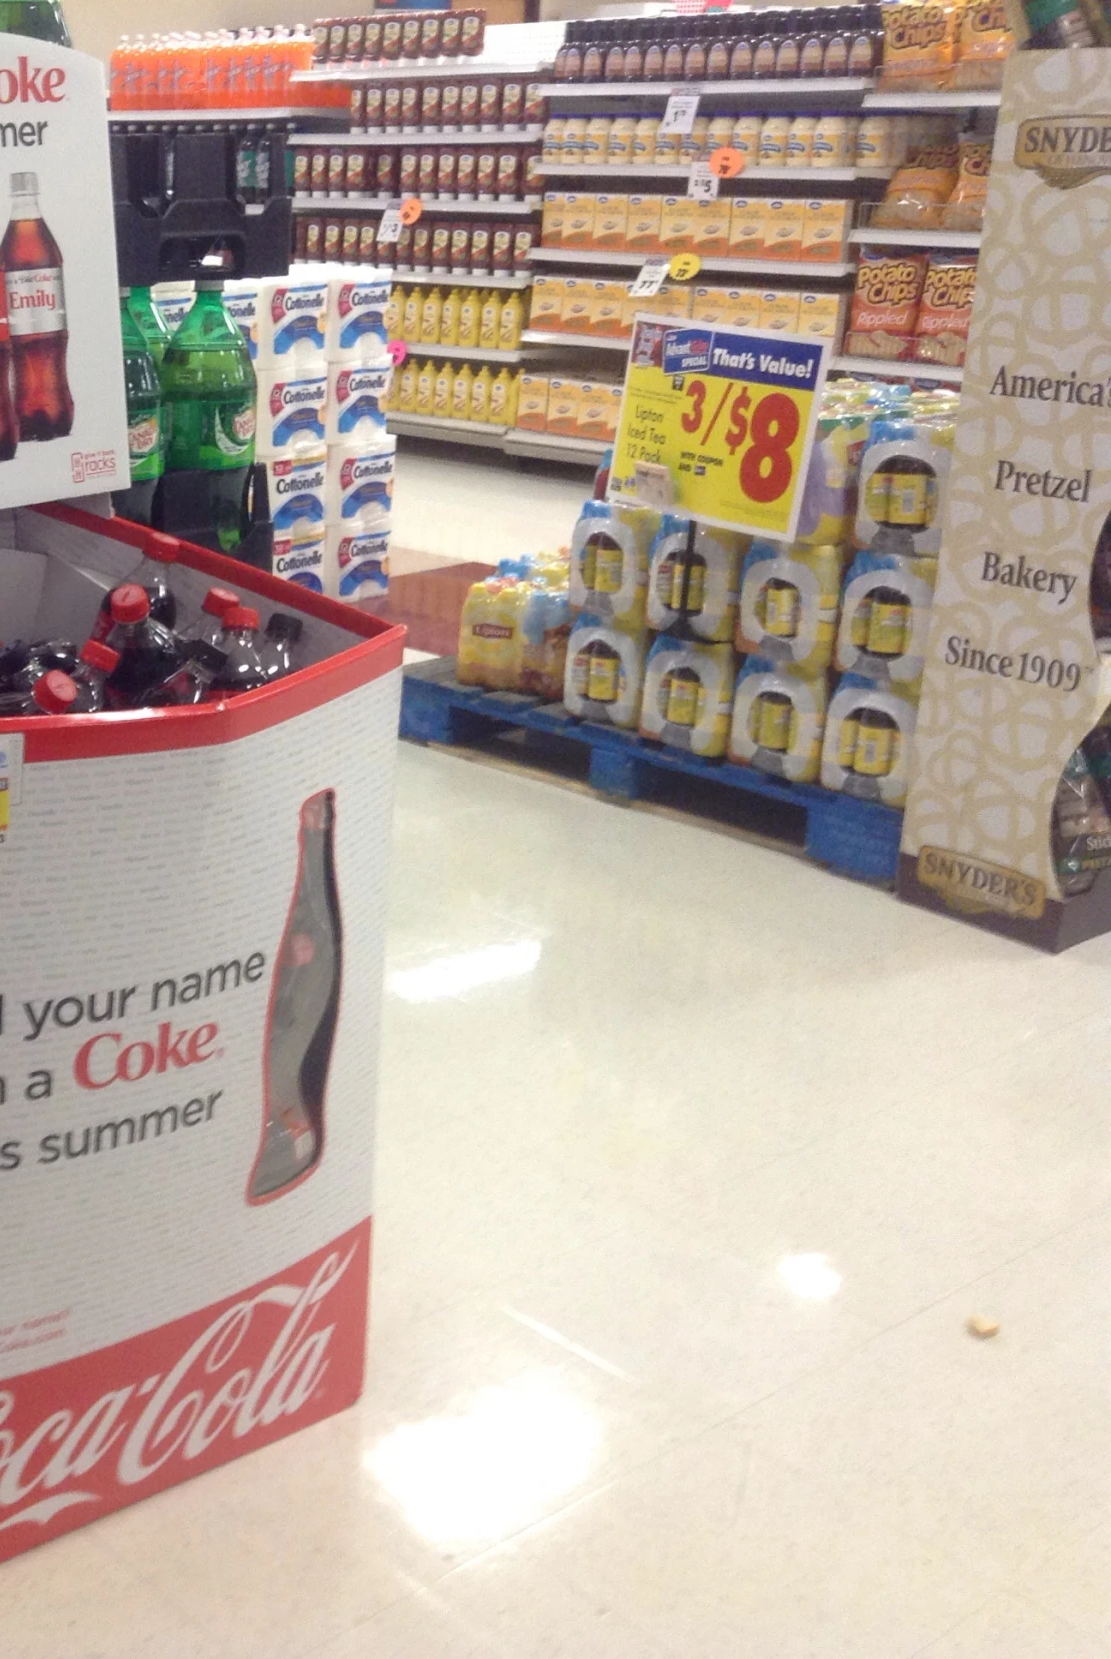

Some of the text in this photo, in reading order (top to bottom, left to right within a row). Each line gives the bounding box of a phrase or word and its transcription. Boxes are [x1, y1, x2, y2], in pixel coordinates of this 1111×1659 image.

[857, 262, 916, 289] Potato
[924, 266, 977, 293] Potat
[9, 288, 57, 311] Emily
[867, 282, 919, 306] Chips
[856, 309, 909, 325] Rippled
[713, 347, 813, 379] That's Value!
[284, 386, 325, 404] Cottonelle
[635, 404, 665, 423] Lipton
[627, 423, 667, 445] Iced Tea
[639, 446, 662, 463] Pack
[354, 461, 393, 479] Cottonelle
[994, 459, 1093, 503] Pretzel
[276, 472, 324, 494] Cottonelle
[351, 540, 388, 557] Cottonelle
[276, 550, 323, 573] Cottonelle
[981, 551, 1078, 605] Bakery
[945, 635, 1081, 692] Since 1909
[923, 852, 1037, 907] SNYDER'S
[23, 984, 137, 1041] your
[151, 950, 266, 1011] name
[25, 1068, 52, 1101] a
[73, 1021, 220, 1091] Coke
[37, 1088, 224, 1165] summer
